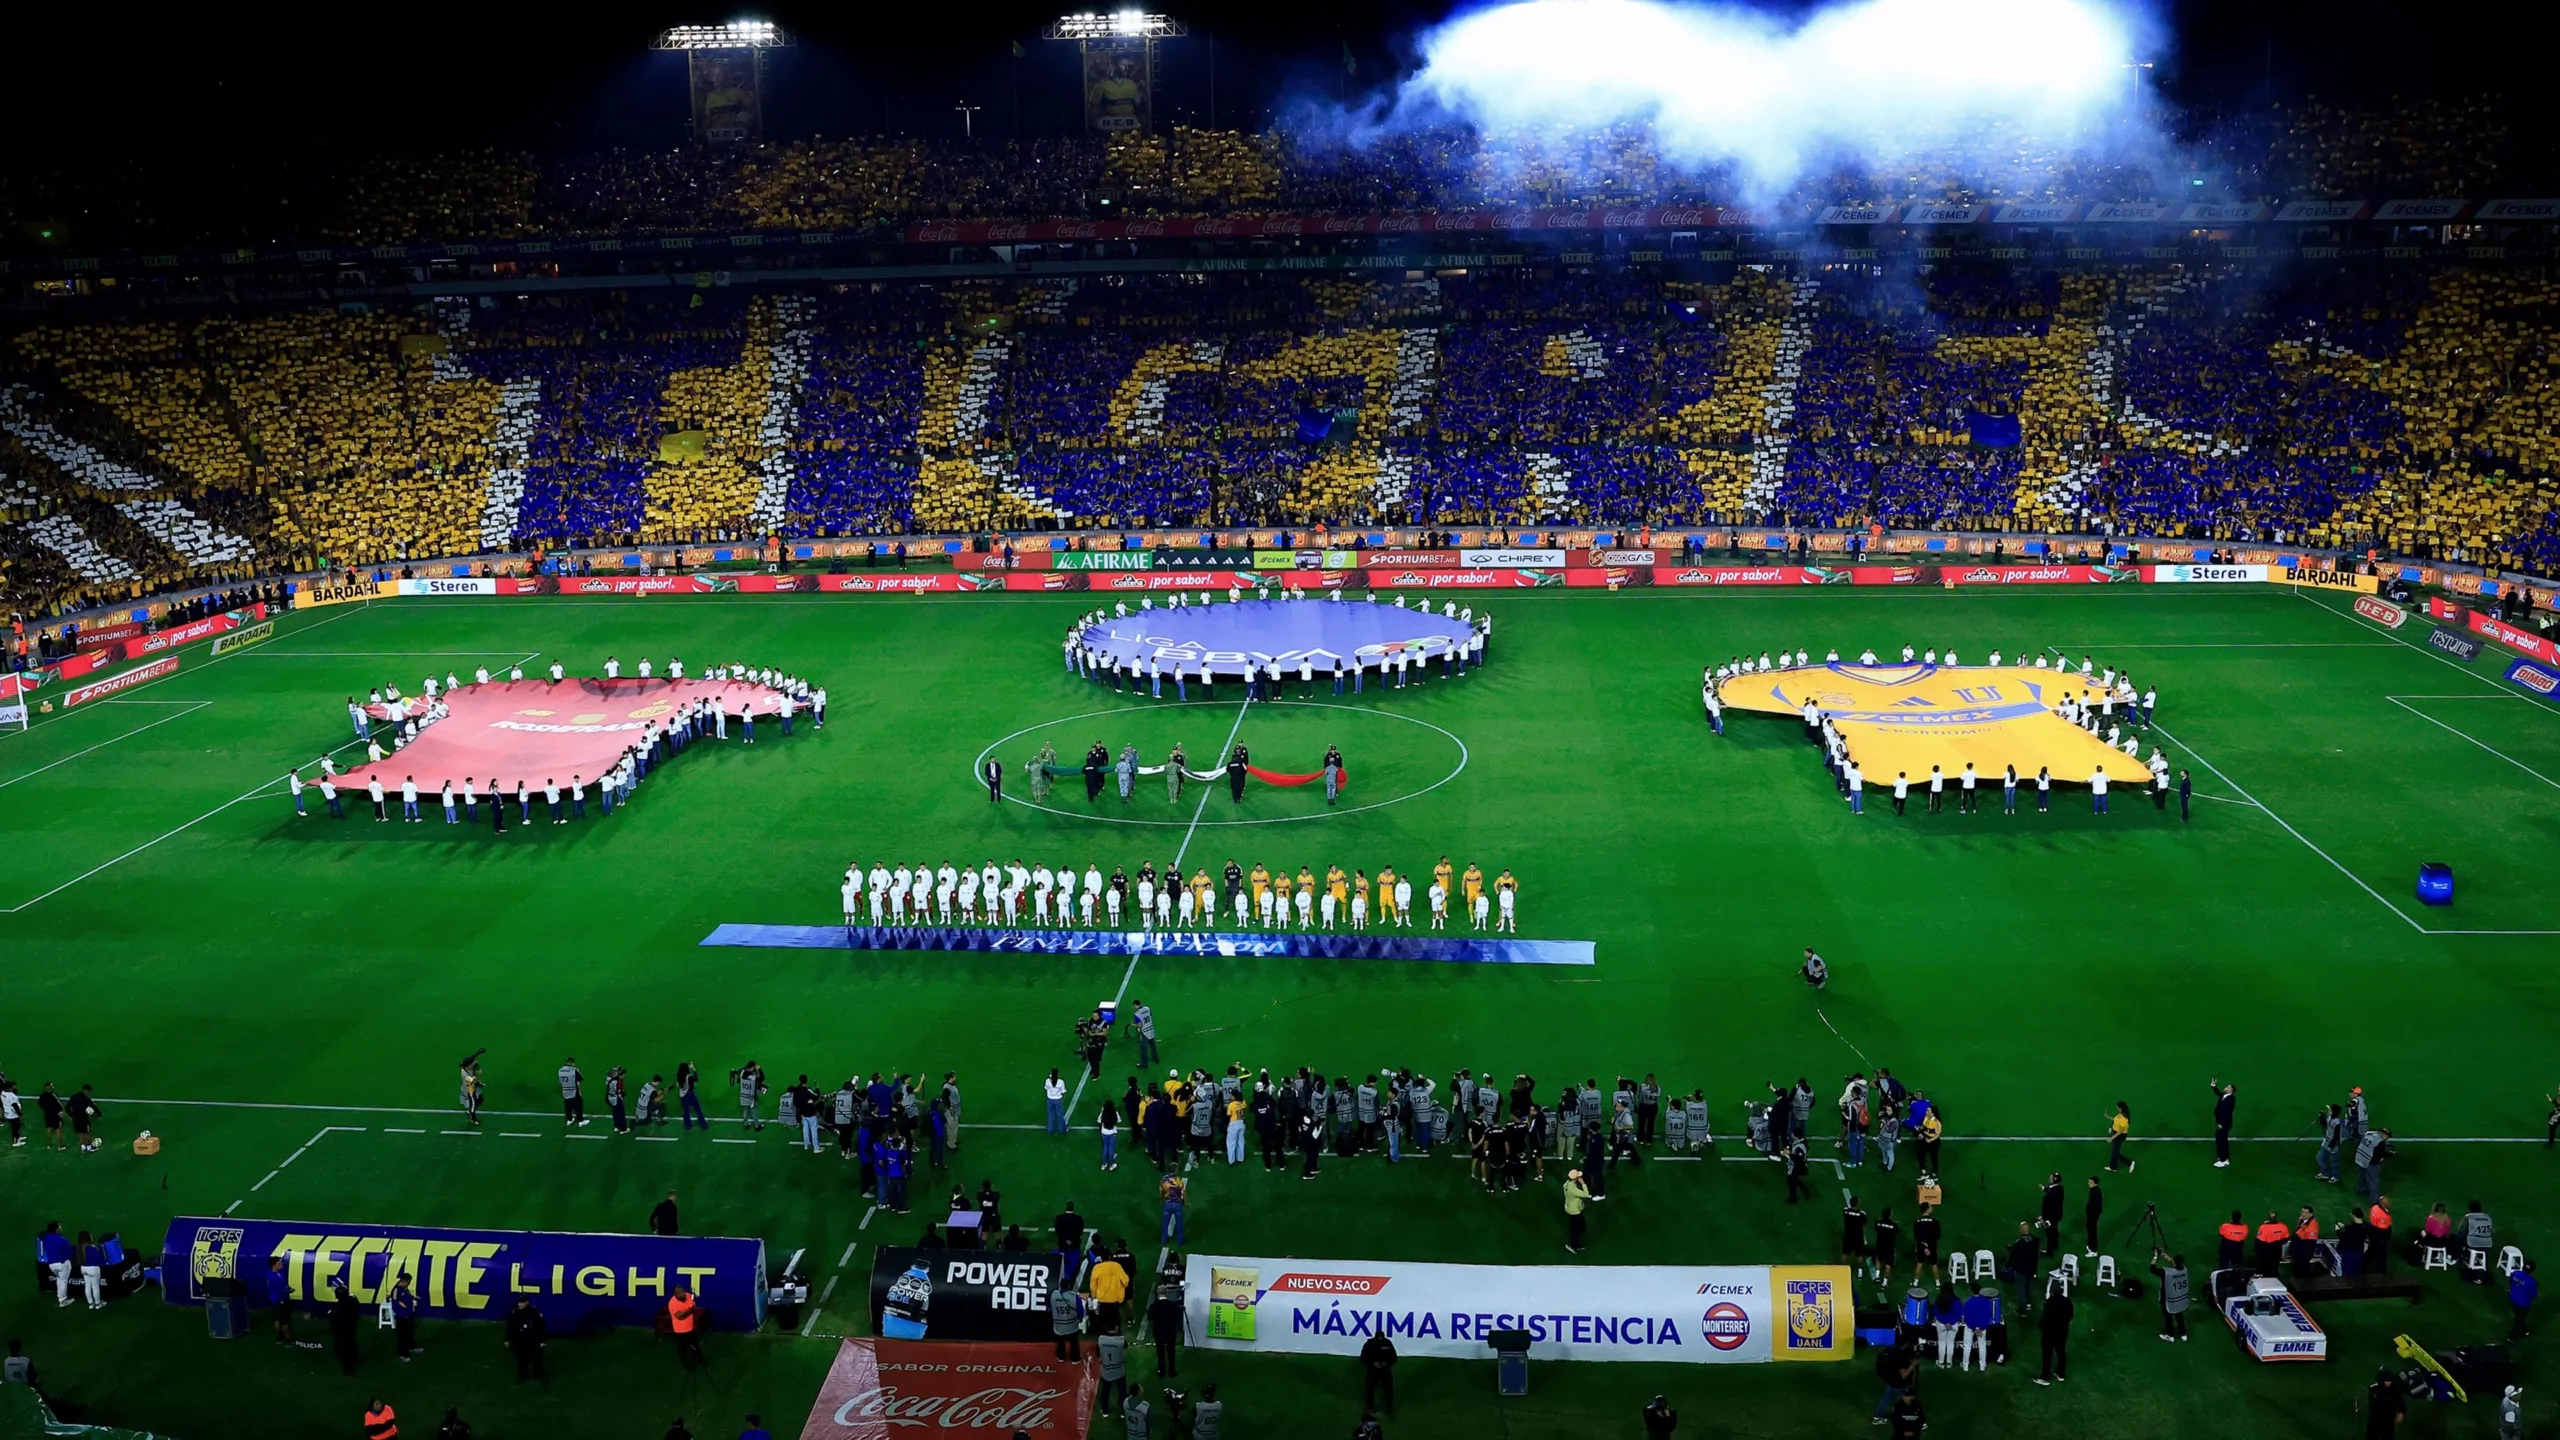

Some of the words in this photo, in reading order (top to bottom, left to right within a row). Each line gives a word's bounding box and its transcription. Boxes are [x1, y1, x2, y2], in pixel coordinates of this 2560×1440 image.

[1842, 211, 1880, 220] CEMEX
[1930, 210, 1970, 220] CEMEX
[2308, 206, 2349, 217] CEMEX
[2405, 205, 2450, 215] CEMEX
[2507, 204, 2555, 215] CEMEX
[1202, 259, 1248, 271] AFIRME
[1281, 257, 1327, 268] AFIRME
[1359, 255, 1406, 268] AFIRME
[1439, 254, 1486, 266] AFIRME
[1081, 553, 1148, 569] AFIRME
[1498, 553, 1555, 563] CHIREY
[1429, 573, 1452, 586] ¡por
[1453, 571, 1493, 584] sabor!
[1714, 571, 1737, 584] ¡por
[1741, 569, 1779, 581] sabor!
[2002, 571, 2025, 583] ¡por
[2026, 568, 2067, 580] sabor!
[2192, 567, 2247, 579] Steren
[2286, 566, 2358, 587] BARDAHL
[430, 581, 478, 592] Steren
[615, 578, 636, 593] ¡por
[638, 578, 673, 590] sabor!
[876, 578, 899, 592] ¡por
[901, 575, 938, 588] sabor!
[1148, 576, 1171, 589] ¡por
[1172, 573, 1212, 586] sabor!
[313, 580, 381, 602] BARDAHL
[169, 631, 189, 647] ¡por
[190, 623, 211, 639] sabor!
[219, 623, 272, 651] BARDAHL
[1110, 629, 1208, 651] LIGA
[2501, 630, 2517, 645] ¡por
[2516, 633, 2538, 652] sabor!
[1152, 646, 1344, 664] BBVA
[2515, 668, 2555, 691] BIMBO
[1881, 710, 1995, 724] CEMEX
[1413, 1096, 1428, 1104] 123
[1688, 1113, 1704, 1121] 166
[1669, 1123, 1684, 1131] 143
[197, 1228, 242, 1244] TIGRES
[2477, 1225, 2492, 1234] 125
[271, 1234, 500, 1309] TECATE
[511, 1262, 716, 1298] LIGHT
[946, 1261, 1050, 1287] POWER
[1225, 1279, 1253, 1287] CEMEX
[1288, 1278, 1333, 1290] NUEVO
[1335, 1279, 1371, 1291] SACO
[1788, 1281, 1831, 1294] TIGRES
[2173, 1280, 2188, 1290] 135
[888, 1285, 930, 1303] POWER
[1710, 1285, 1753, 1295] CEMEX
[886, 1292, 910, 1305] ADE
[991, 1286, 1047, 1311] ADE
[1055, 1305, 1071, 1315] 159
[1214, 1305, 1222, 1335] CEMENTO
[1292, 1299, 1441, 1339] MÁXIMA
[1451, 1313, 1682, 1346] RESISTENCIA
[1703, 1319, 1749, 1333] MONTERREY
[2230, 1307, 2258, 1348] EMME
[295, 1340, 323, 1349] POLICIA
[1797, 1338, 1824, 1348] UANL
[2273, 1343, 2316, 1353] EMME
[1107, 1354, 1112, 1362] 1
[877, 1362, 950, 1373] SABOR
[956, 1364, 1057, 1374] ORIGINAL
[833, 1386, 1070, 1429] Coca-Cola
